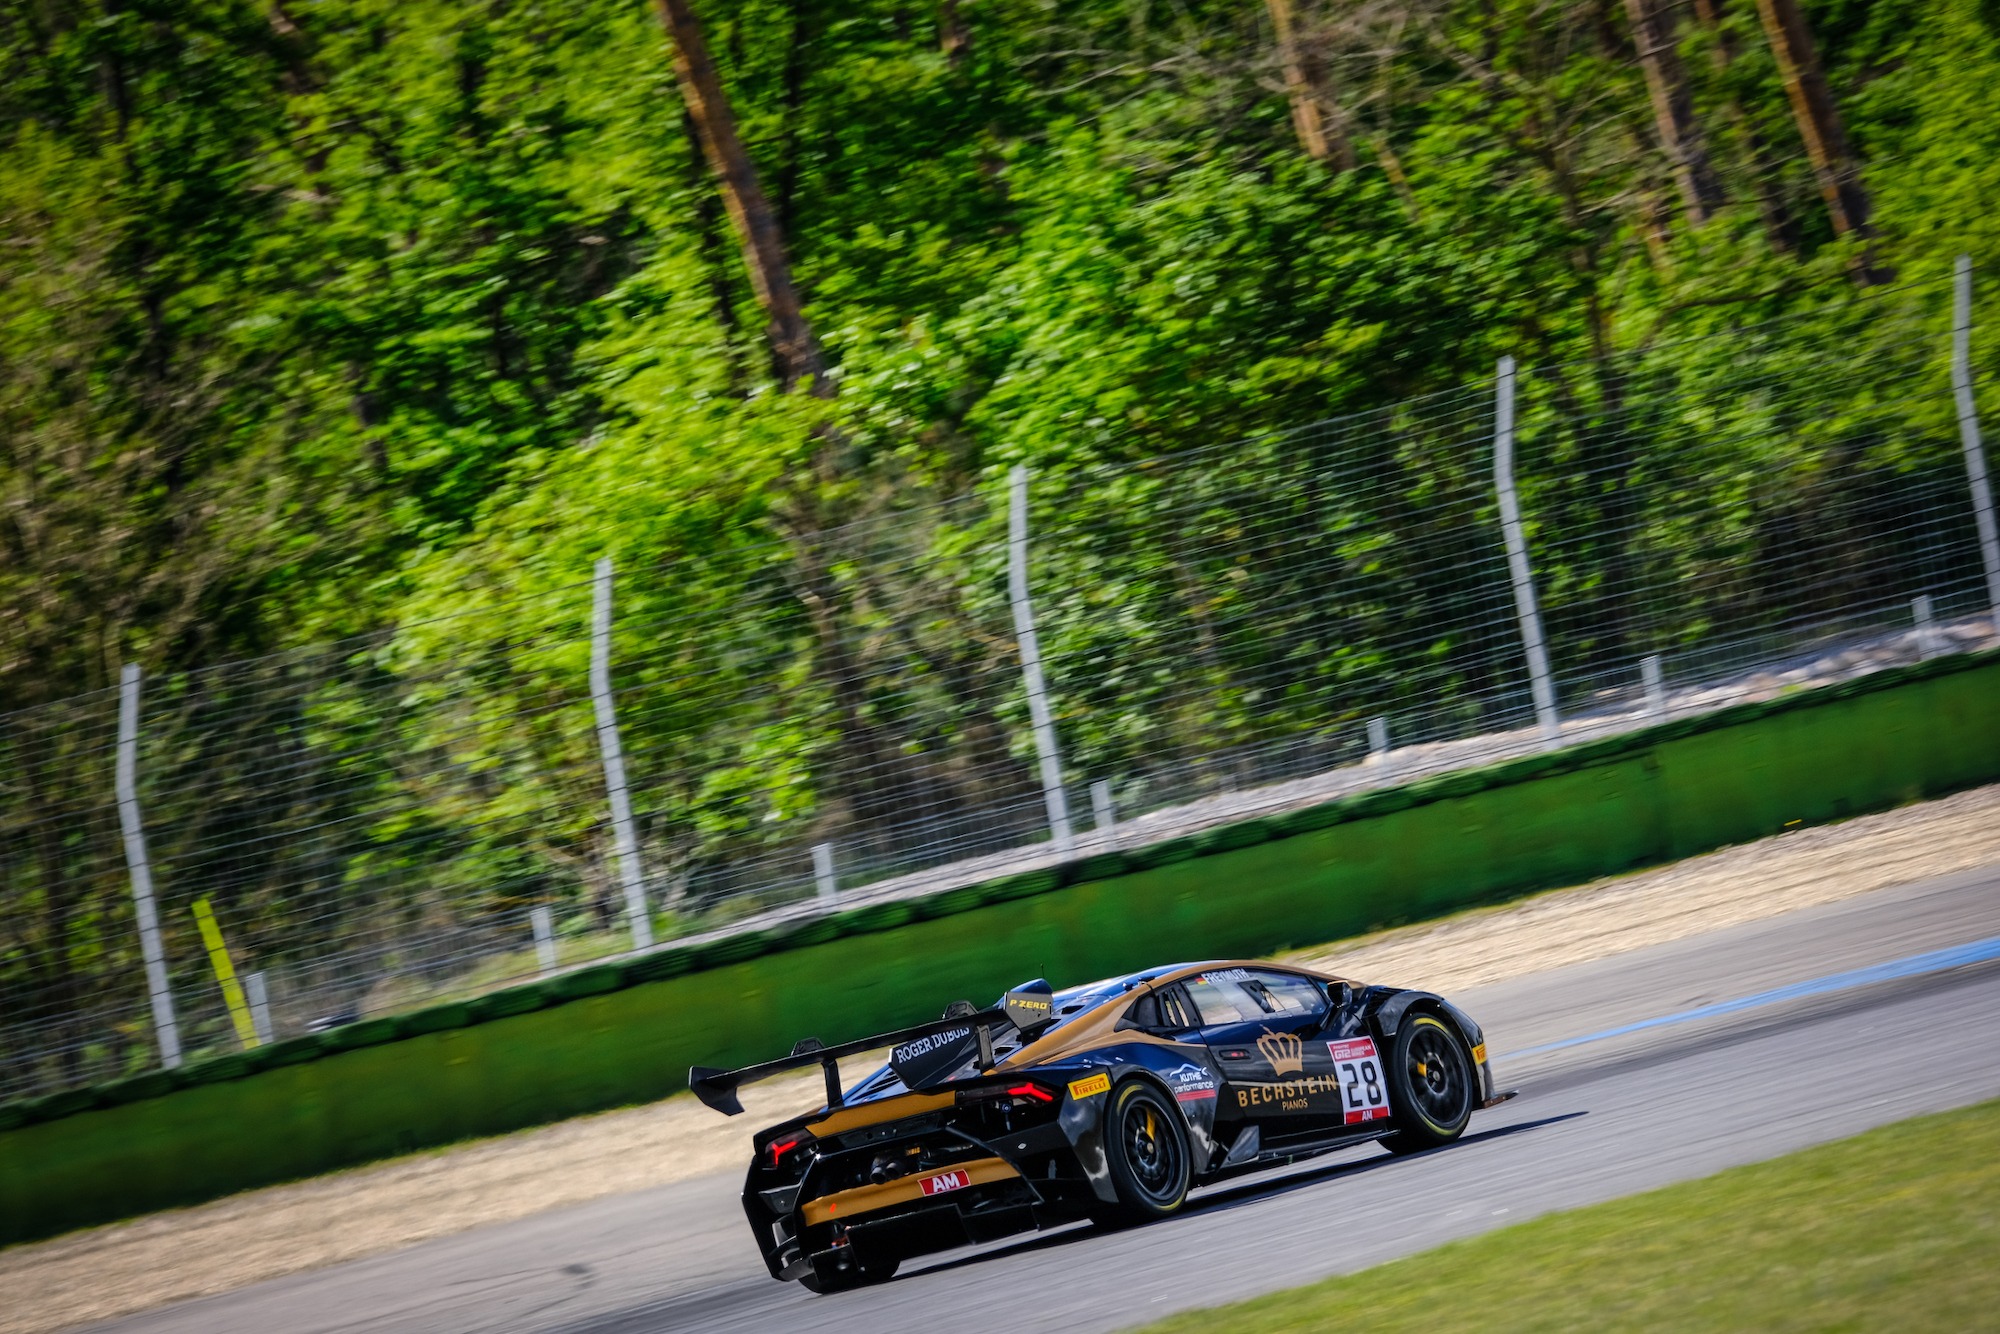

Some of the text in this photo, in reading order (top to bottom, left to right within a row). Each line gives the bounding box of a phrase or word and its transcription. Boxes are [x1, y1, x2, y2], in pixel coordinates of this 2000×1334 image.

[1201, 968, 1250, 984] FREYMUTH
[1010, 999, 1048, 1010] P ZERO
[896, 1037, 933, 1064] ROGER
[1073, 1077, 1107, 1096] PIRELLI
[1174, 1080, 1214, 1094] performance
[1237, 1073, 1338, 1108] BECHSTEIN
[1342, 1060, 1382, 1108] 28
[1282, 1098, 1309, 1111] PIANOS
[1361, 1110, 1373, 1121] AM
[932, 1172, 961, 1193] AM
